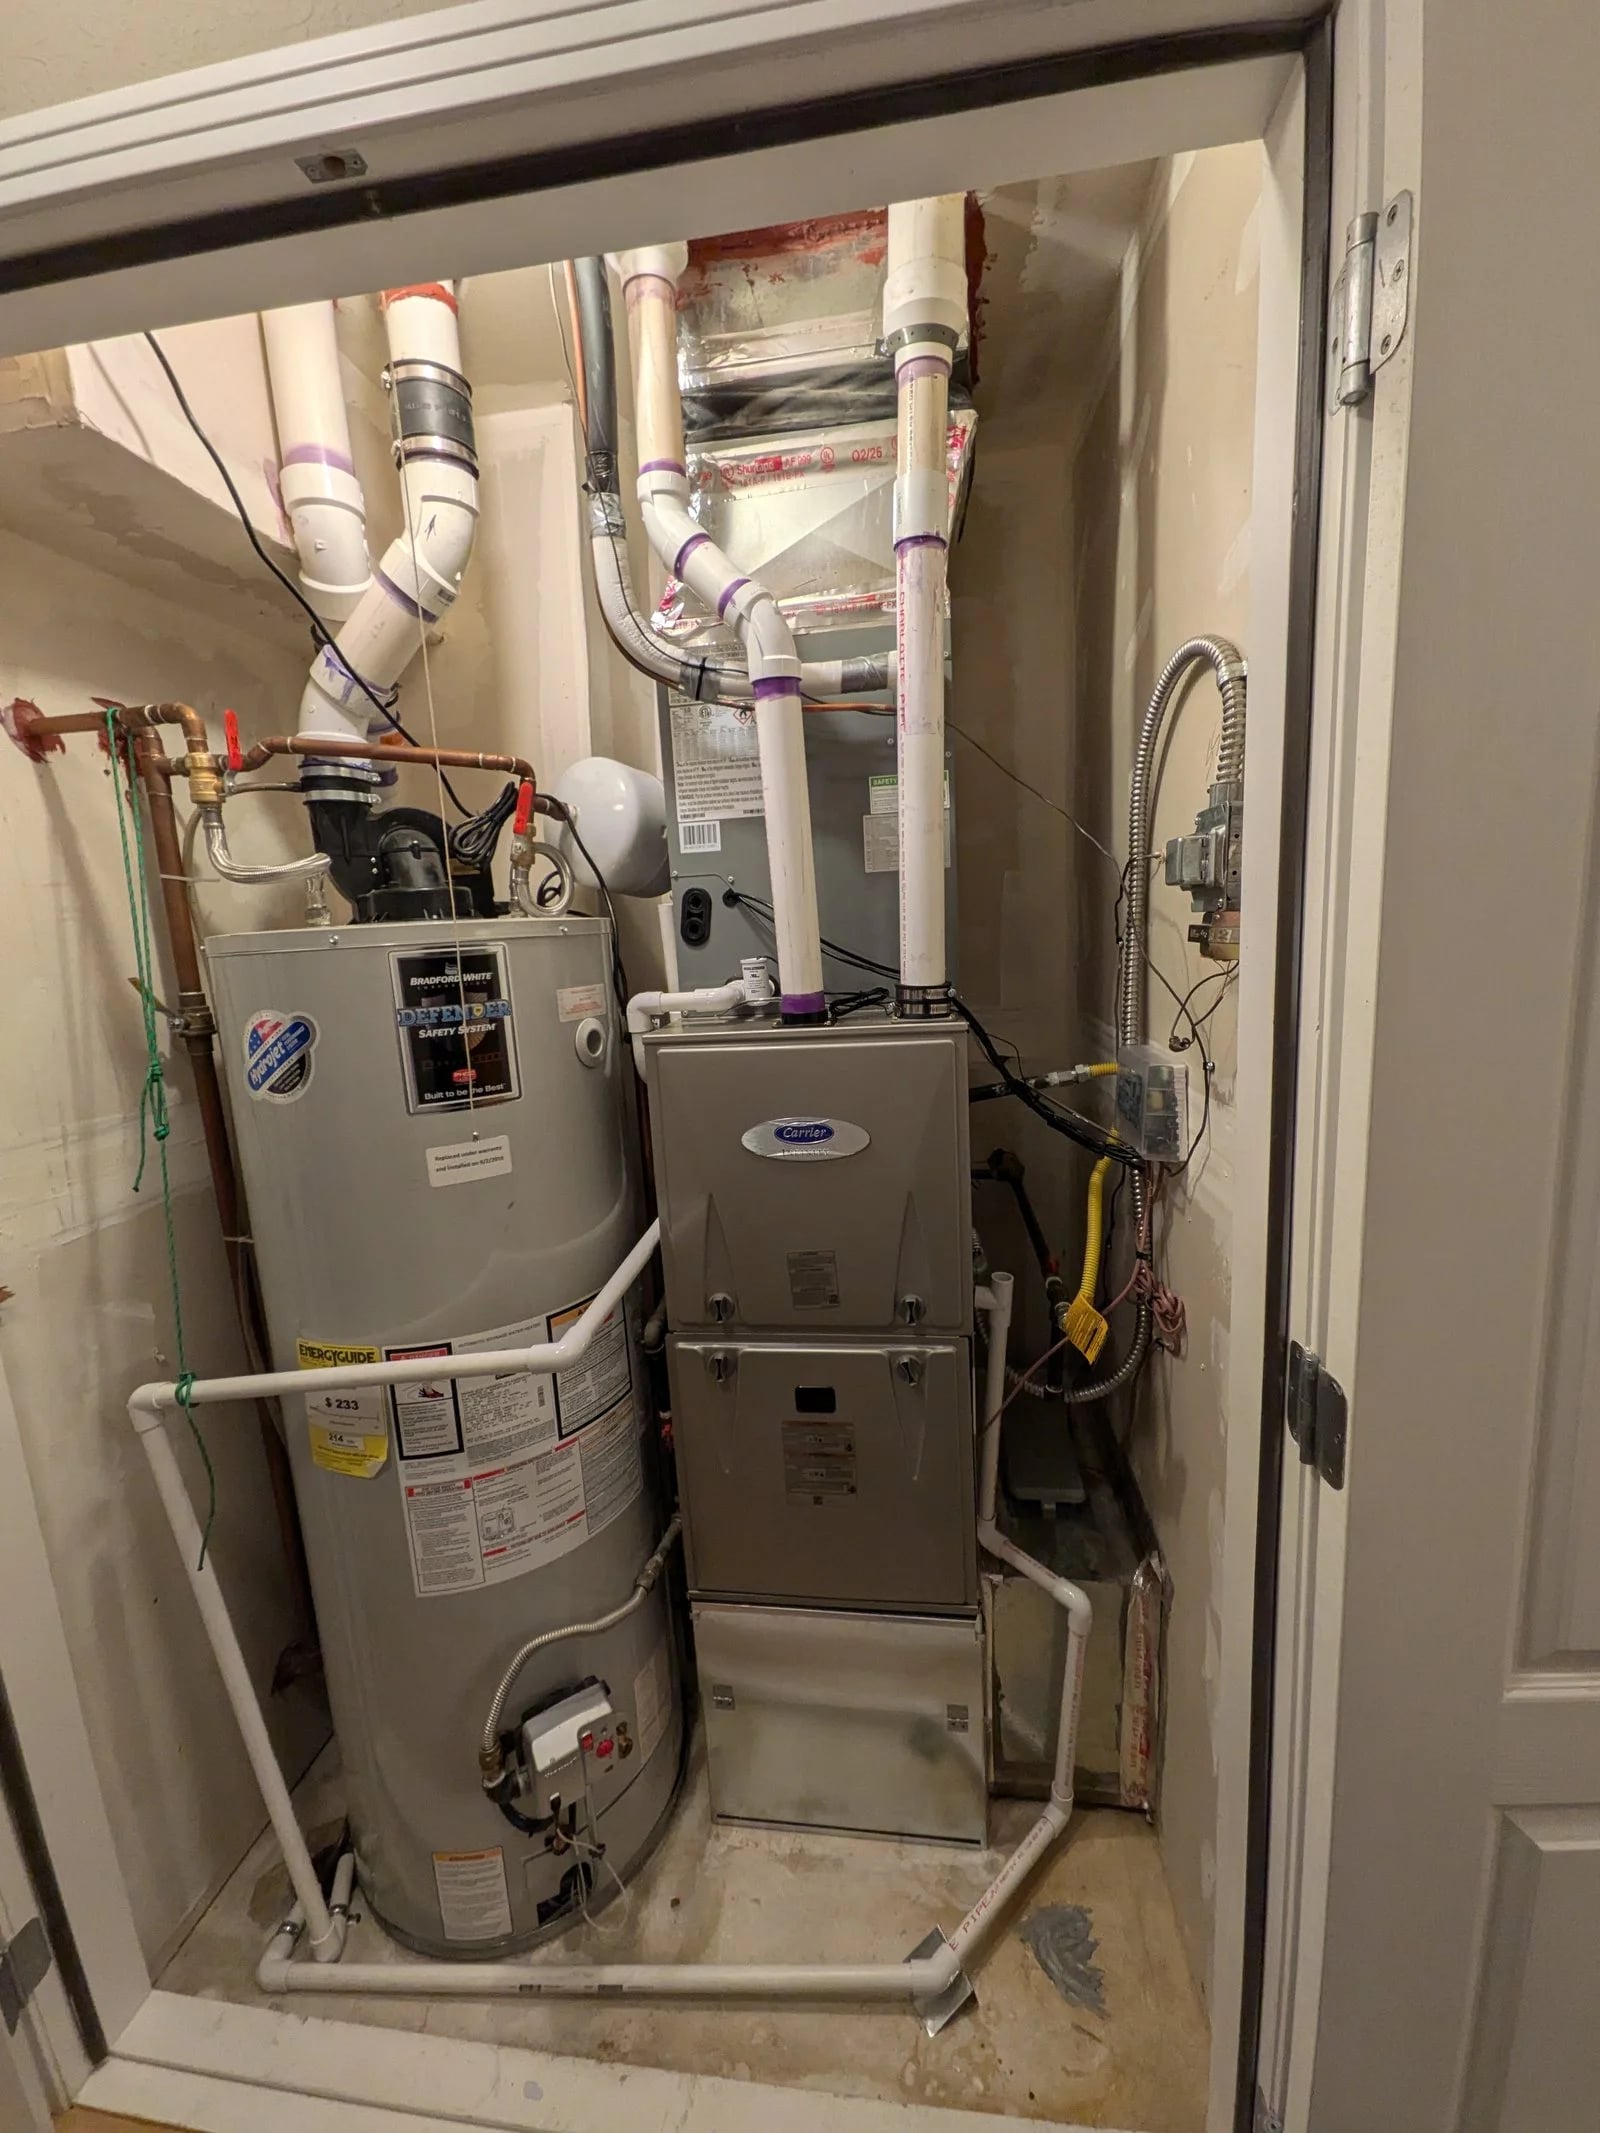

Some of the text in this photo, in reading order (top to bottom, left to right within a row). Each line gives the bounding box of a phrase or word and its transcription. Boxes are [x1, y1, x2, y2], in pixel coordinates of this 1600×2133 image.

[410, 972, 493, 986] BRADFORD WHITE
[398, 1000, 512, 1027] DEFENDER
[418, 1023, 496, 1039] SAFETY SYSTEM
[249, 1040, 287, 1085] Hydrojet
[424, 1091, 444, 1100] Built
[446, 1090, 454, 1098] to
[456, 1088, 468, 1097] be
[485, 1083, 504, 1092] Best
[783, 1127, 827, 1138] Carrier
[434, 1153, 460, 1162] Replaced
[461, 1150, 477, 1158] under
[447, 1162, 470, 1170] installed
[298, 1343, 376, 1367] ENERGYGUIDE
[325, 1396, 359, 1411] $ 233
[962, 1897, 994, 1935] PIPE
